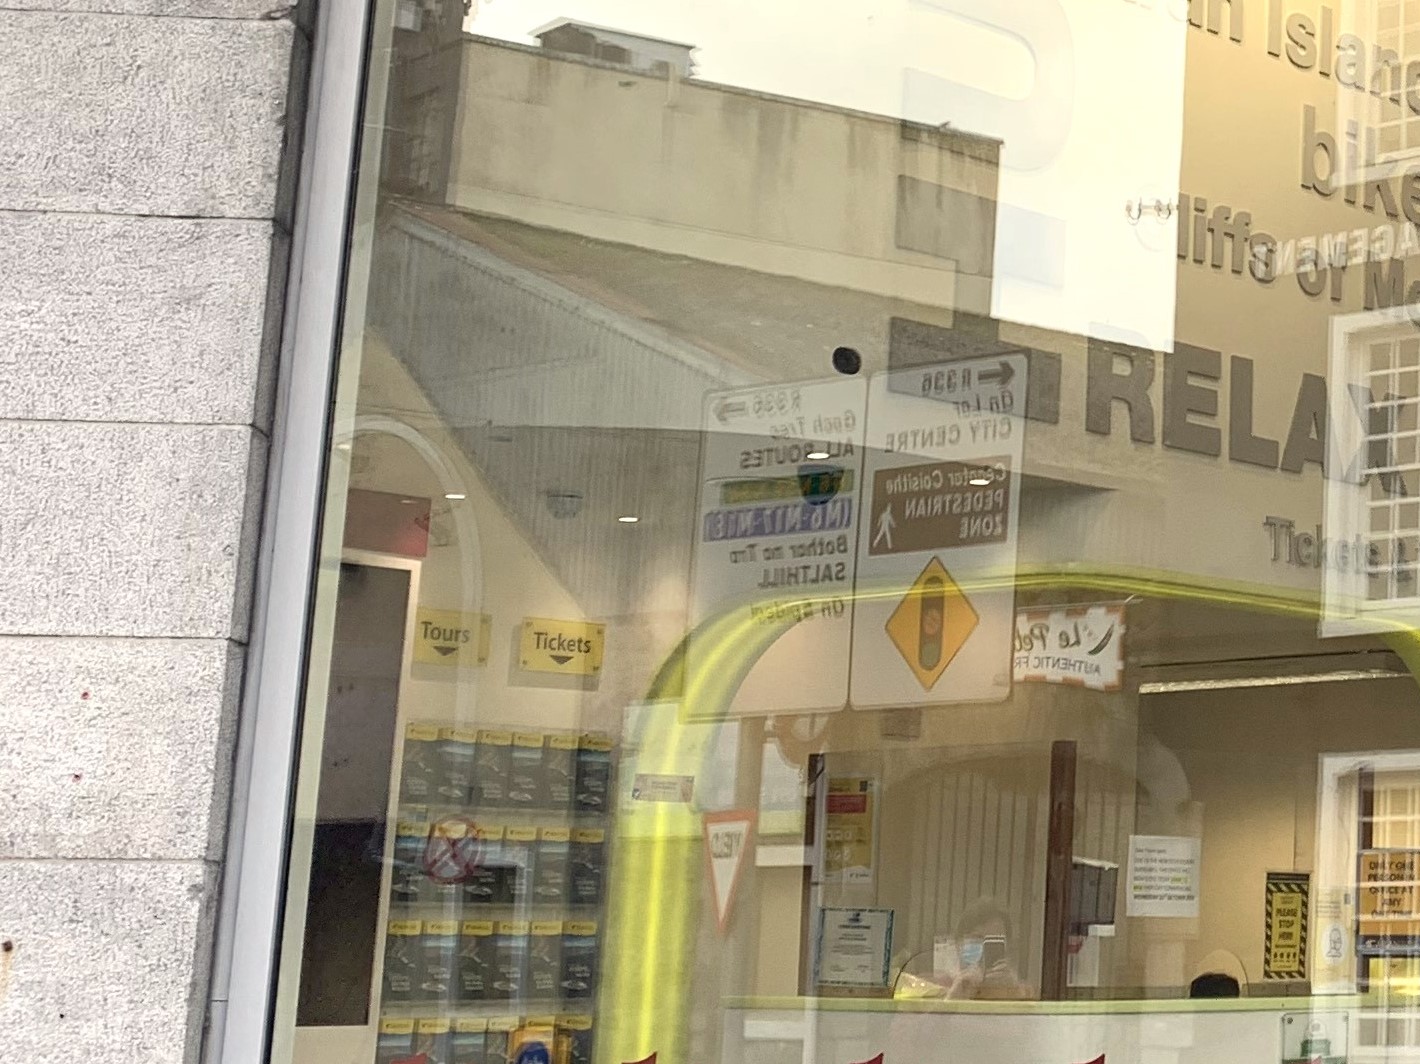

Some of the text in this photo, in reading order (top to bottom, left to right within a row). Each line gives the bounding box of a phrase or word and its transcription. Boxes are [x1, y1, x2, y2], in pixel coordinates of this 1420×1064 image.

[1177, 192, 1278, 284] liffs
[1085, 330, 1408, 495] RELAX
[421, 621, 472, 643] Tours
[534, 632, 592, 653] Tickets
